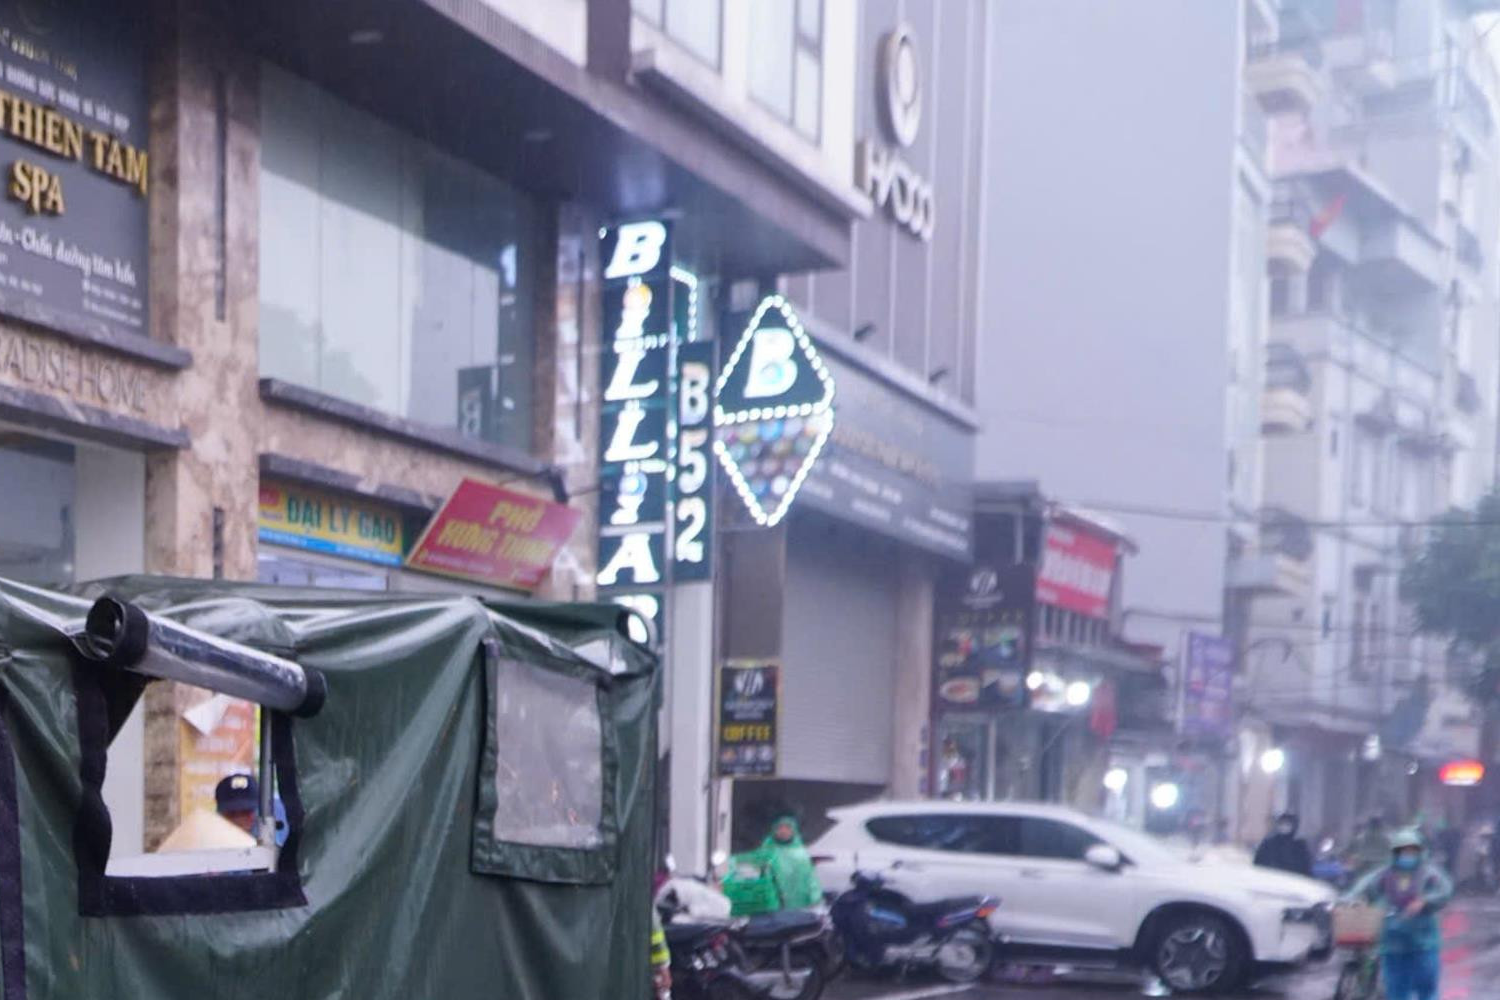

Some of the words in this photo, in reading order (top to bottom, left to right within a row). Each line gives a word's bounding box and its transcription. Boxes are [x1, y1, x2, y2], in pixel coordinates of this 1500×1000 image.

[11, 159, 67, 215] SPA
[78, 348, 148, 413] HOME
[743, 327, 798, 398] B
[675, 361, 710, 563] B52
